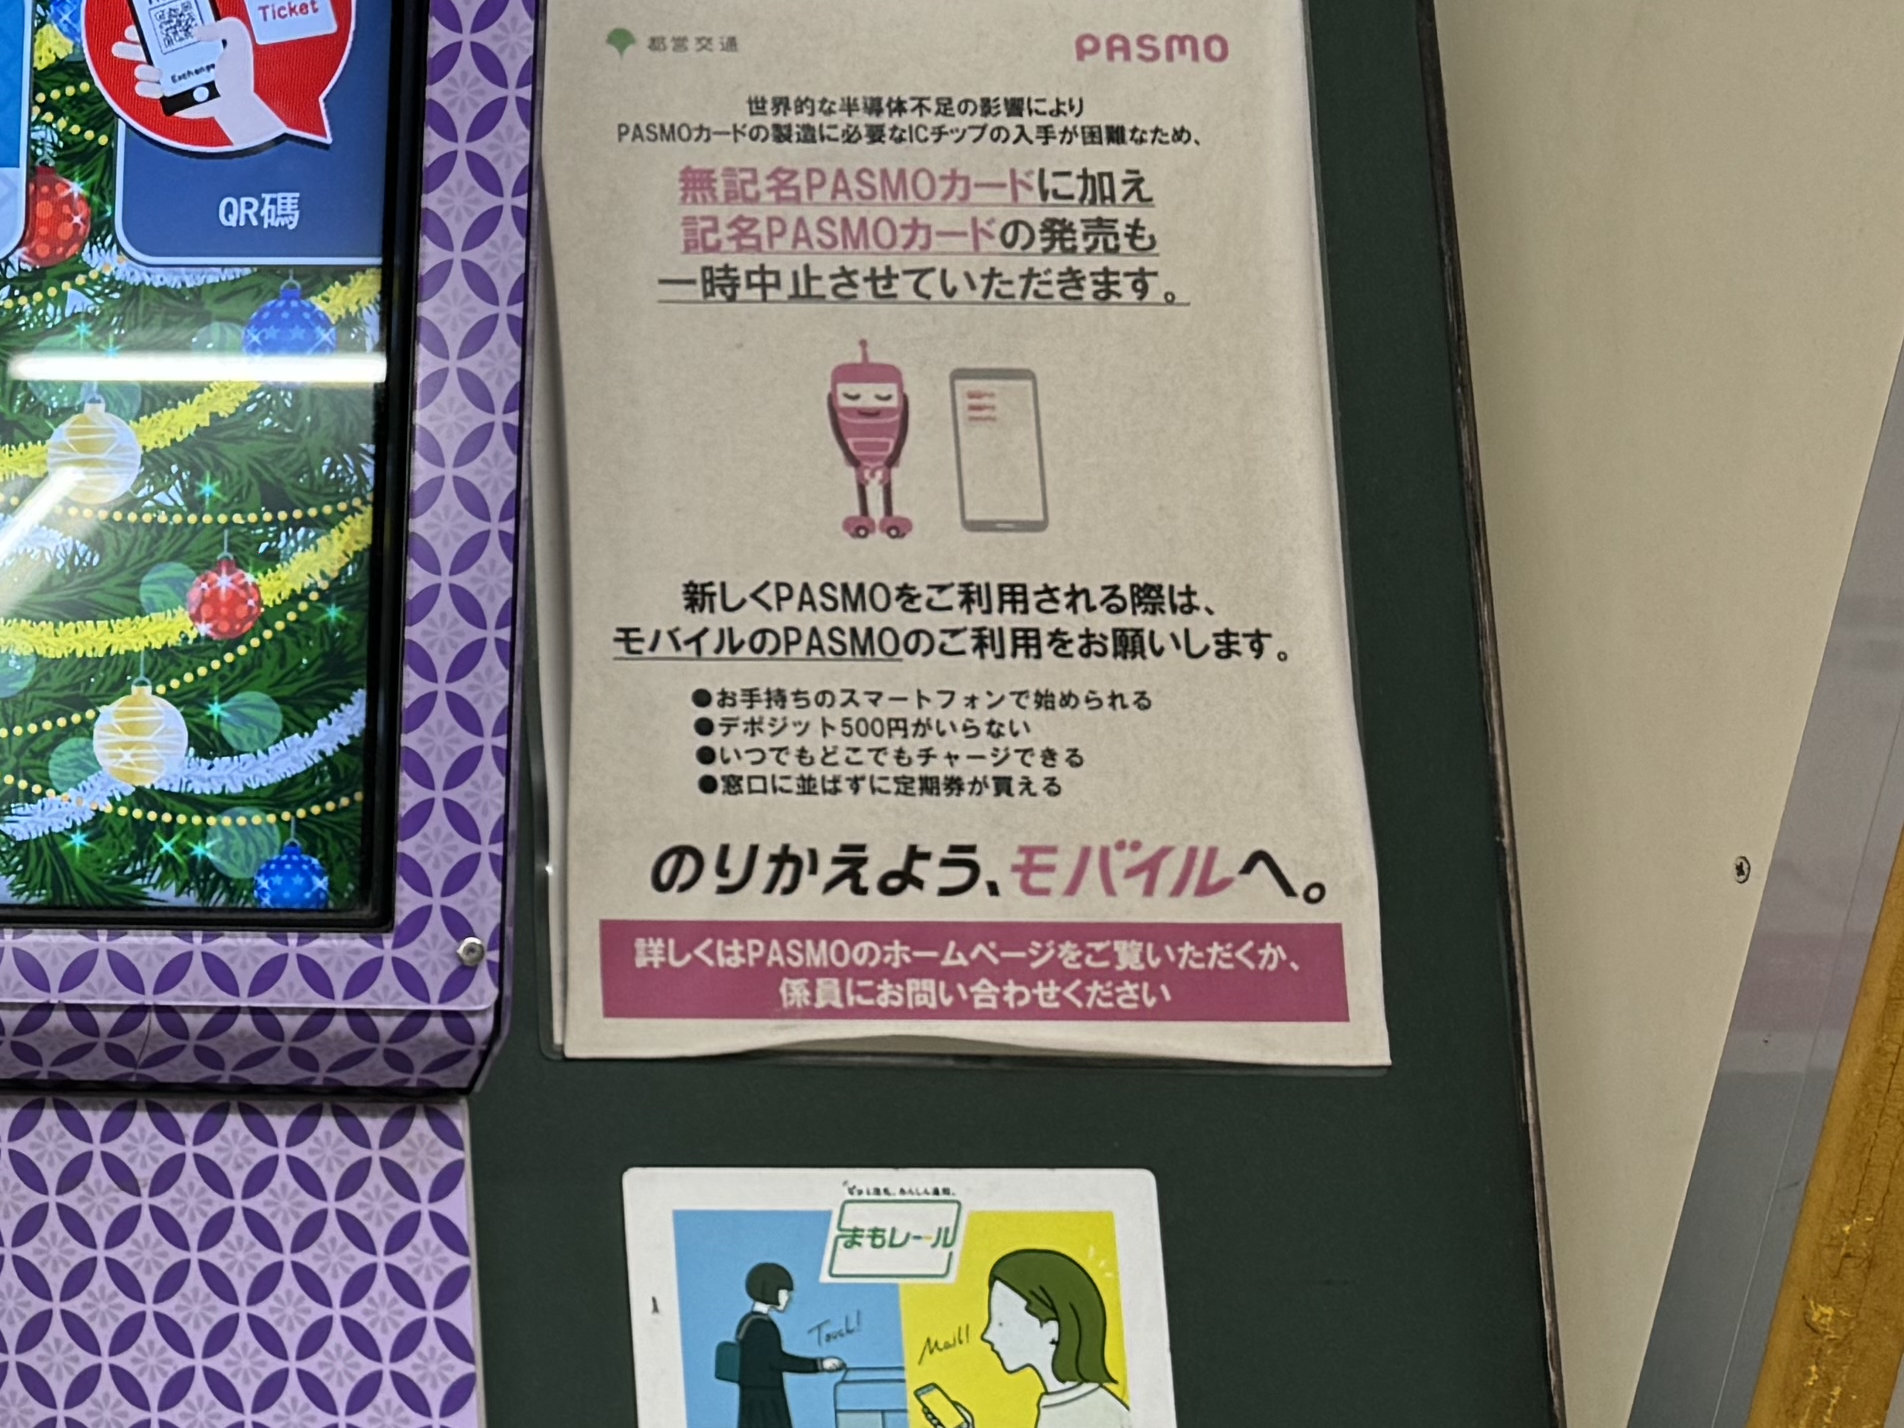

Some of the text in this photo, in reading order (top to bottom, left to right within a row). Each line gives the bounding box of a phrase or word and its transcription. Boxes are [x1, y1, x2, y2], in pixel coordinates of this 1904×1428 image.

[647, 35, 739, 54] 都営交通
[1075, 33, 1230, 64] PASMO
[746, 96, 1086, 119] 世界的な半導体不足の影響により
[679, 165, 1154, 204] 無記名PASMOカードに加え
[218, 192, 300, 230] QR碼
[681, 215, 1158, 254] 記名PASMOカードの発売も
[658, 265, 1177, 304] 一時中止させていただきます。
[682, 580, 1216, 617] 新しくPASMOをご利用される際は、
[612, 625, 1290, 662] モバイルのPASMOのご利用をお願いします。
[650, 838, 1327, 905] のりかえよう、モバイルへ。
[634, 937, 1301, 972] 詳しくはPASMOのホームページをご覧いただくか、
[779, 977, 1172, 1012] 係員にお問い合わせください
